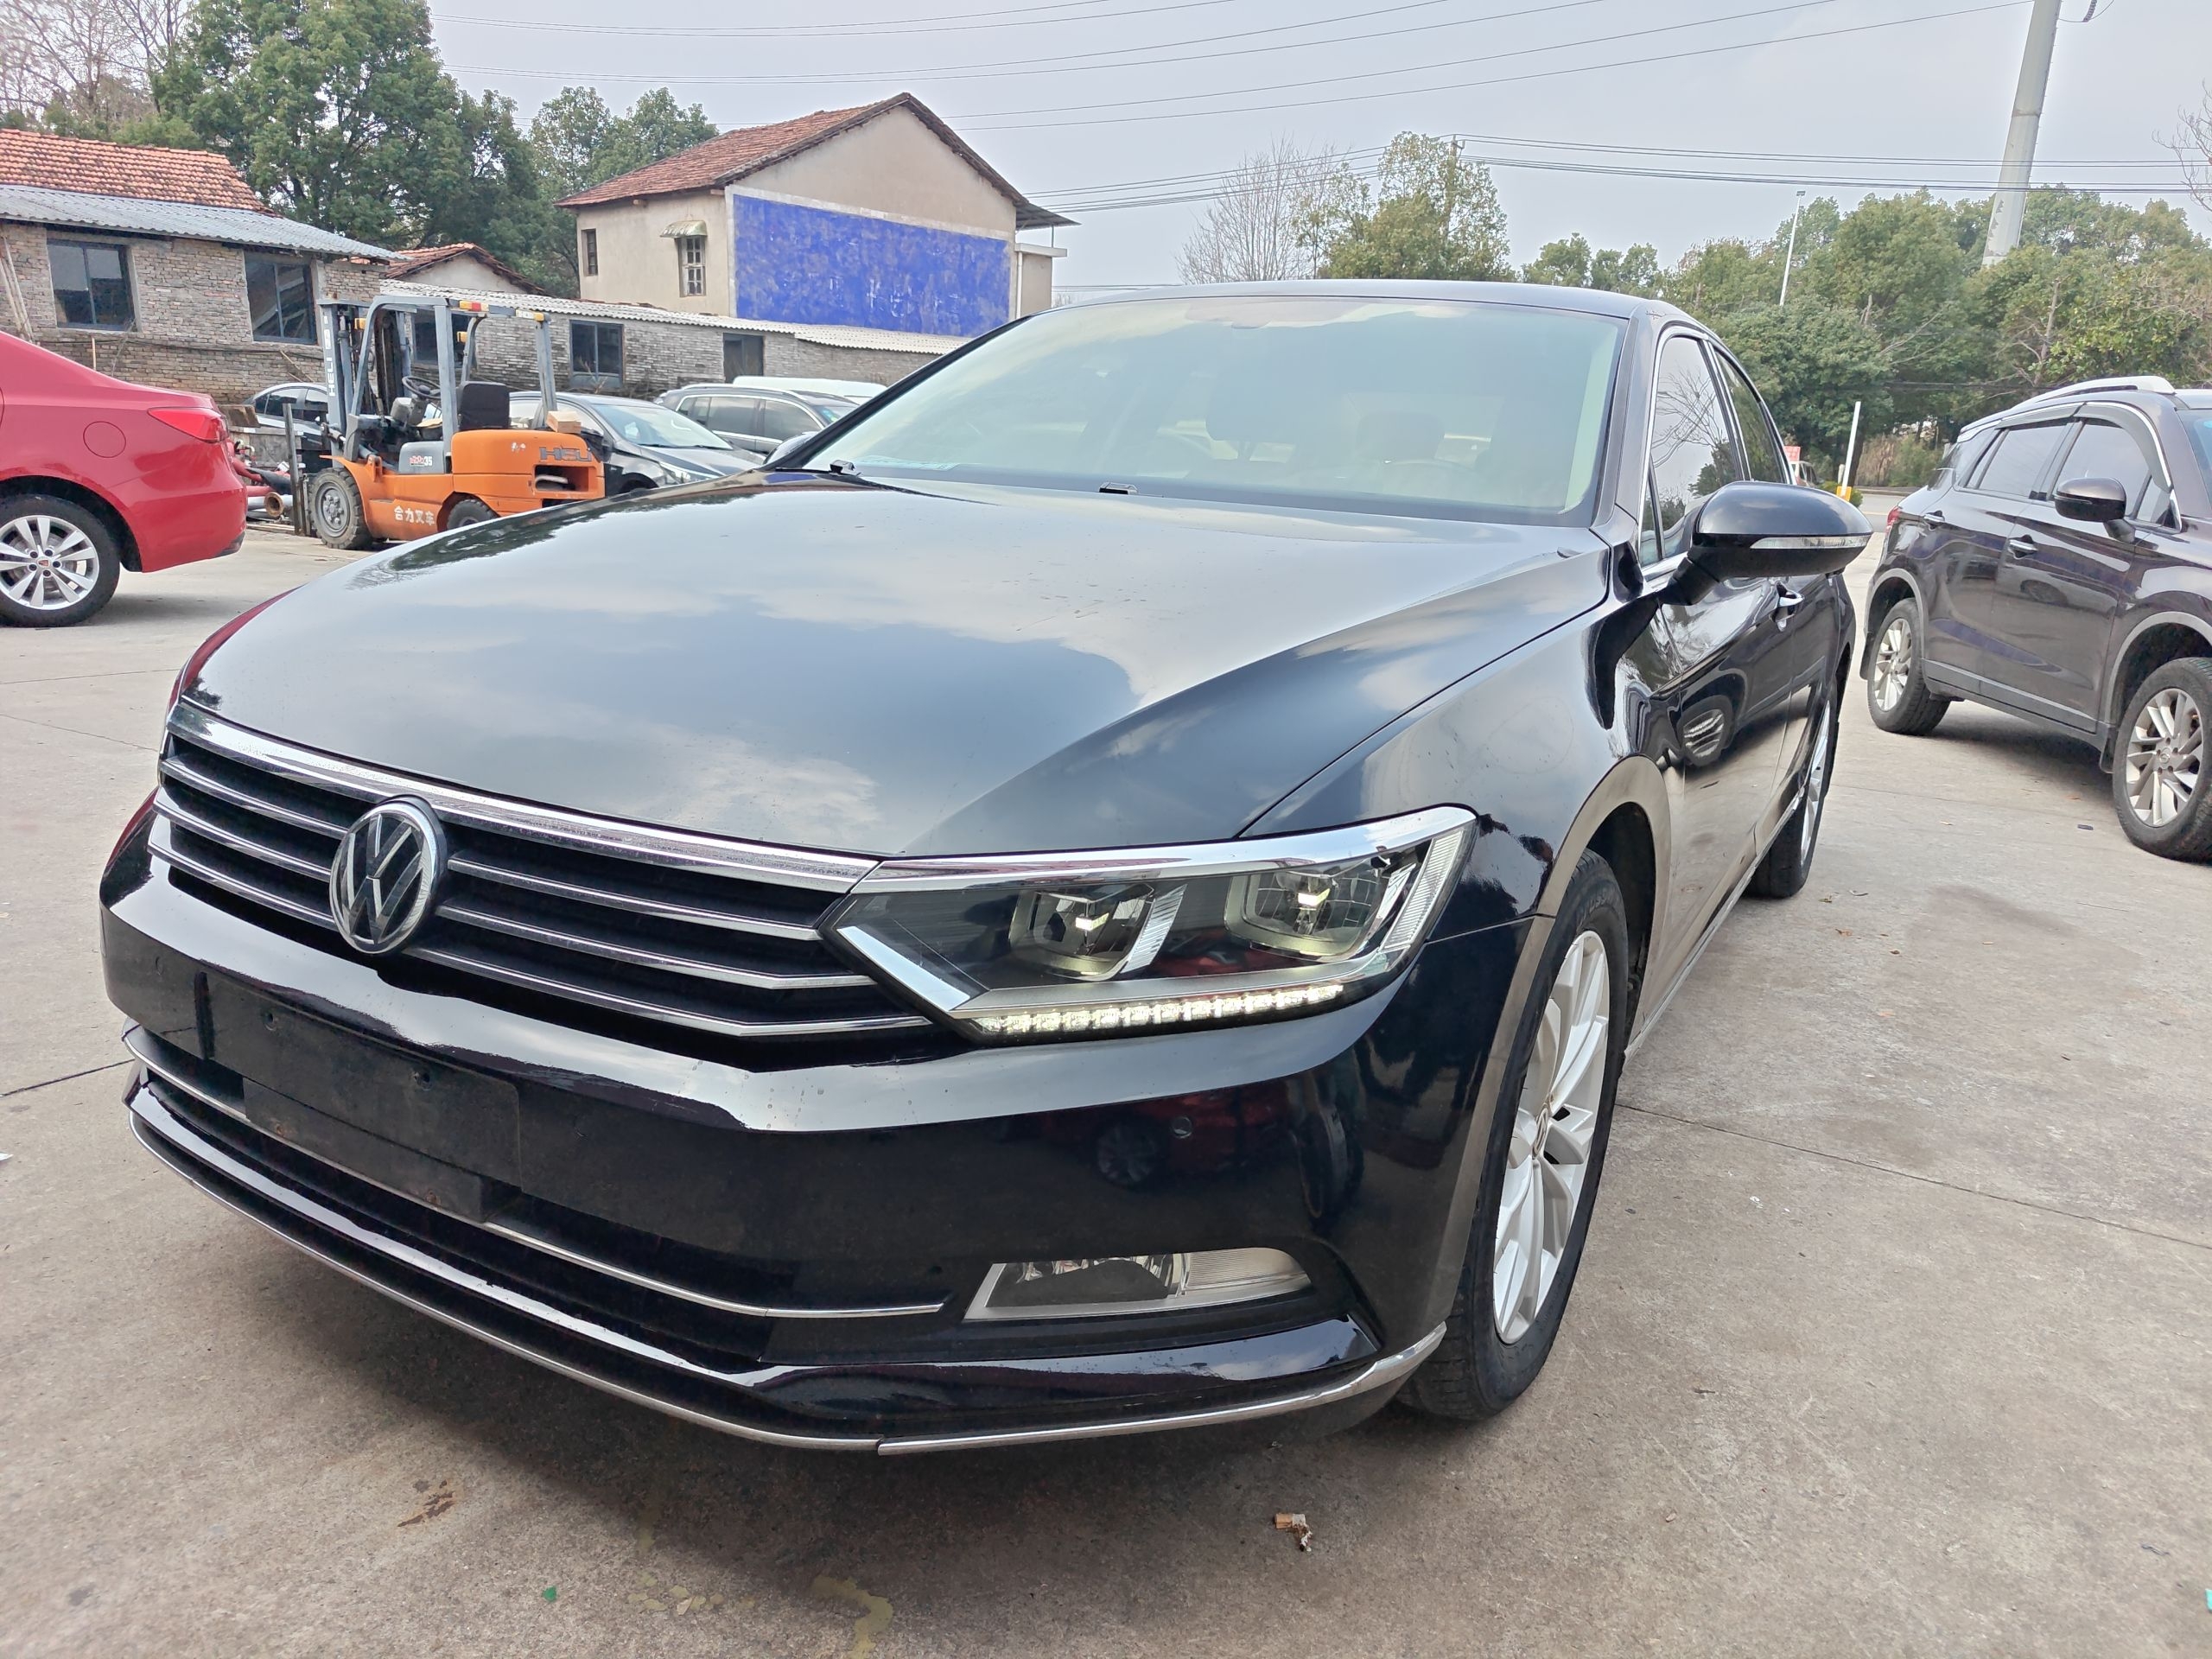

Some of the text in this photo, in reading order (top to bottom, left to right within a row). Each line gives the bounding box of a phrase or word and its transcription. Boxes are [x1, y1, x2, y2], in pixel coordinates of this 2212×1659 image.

[326, 357, 336, 397] HELI
[393, 505, 435, 526] 合力叉车
